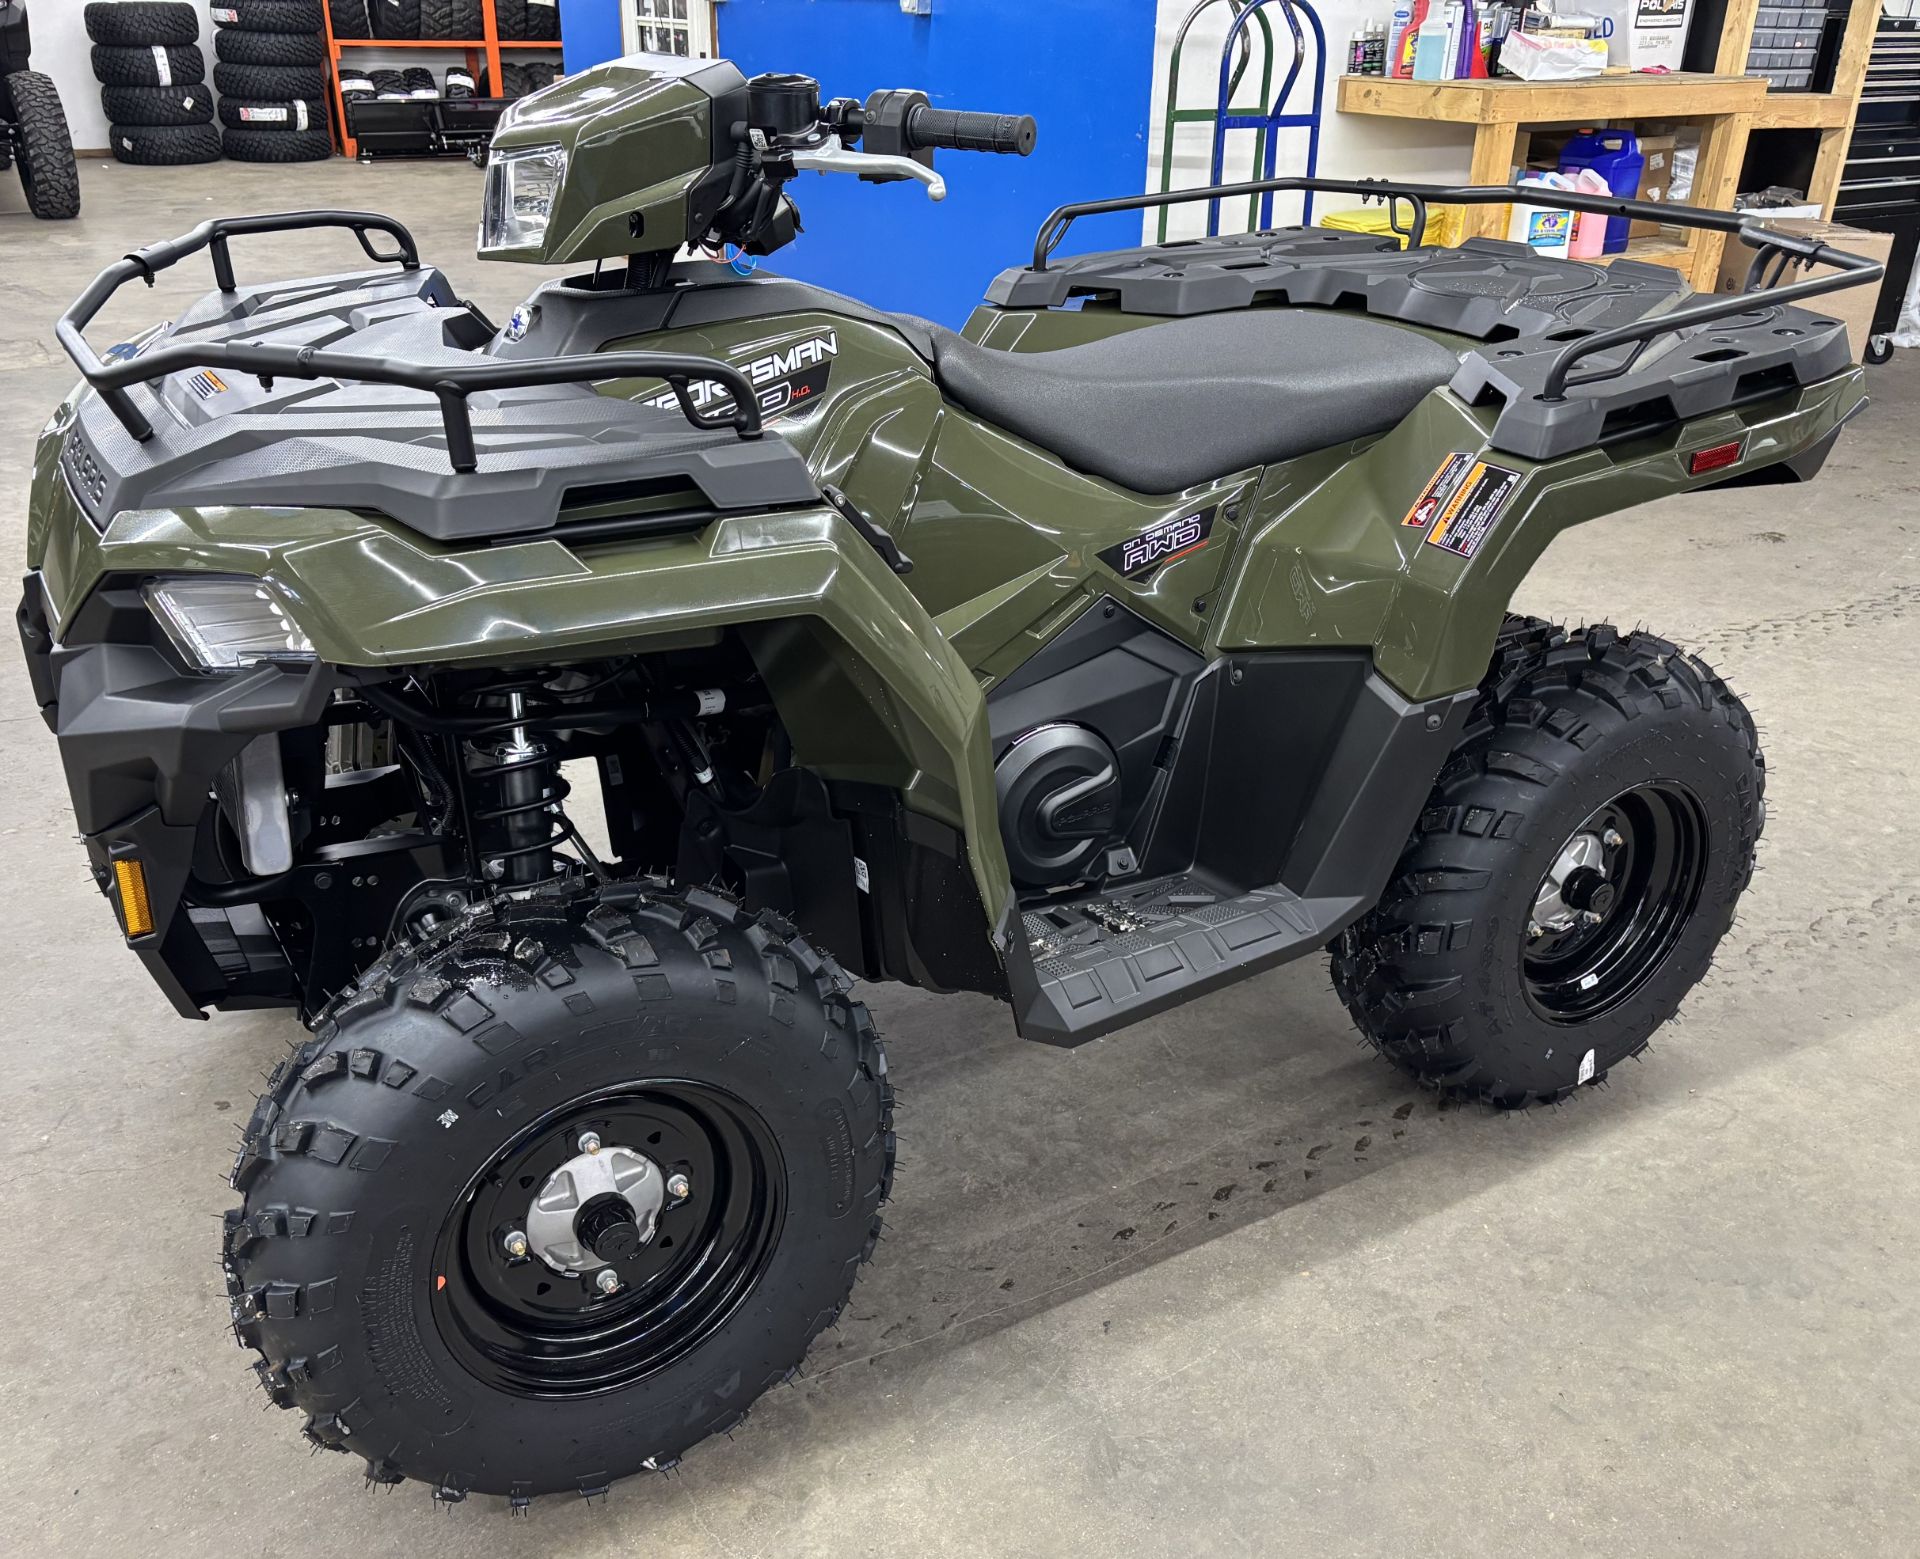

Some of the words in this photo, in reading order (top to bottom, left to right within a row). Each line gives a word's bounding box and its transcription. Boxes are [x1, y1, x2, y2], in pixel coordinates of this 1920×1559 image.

[1446, 481, 1473, 517] WARNING
[1123, 540, 1141, 551] ON
[1146, 514, 1200, 541] DEMAND
[1124, 523, 1200, 571] AWD
